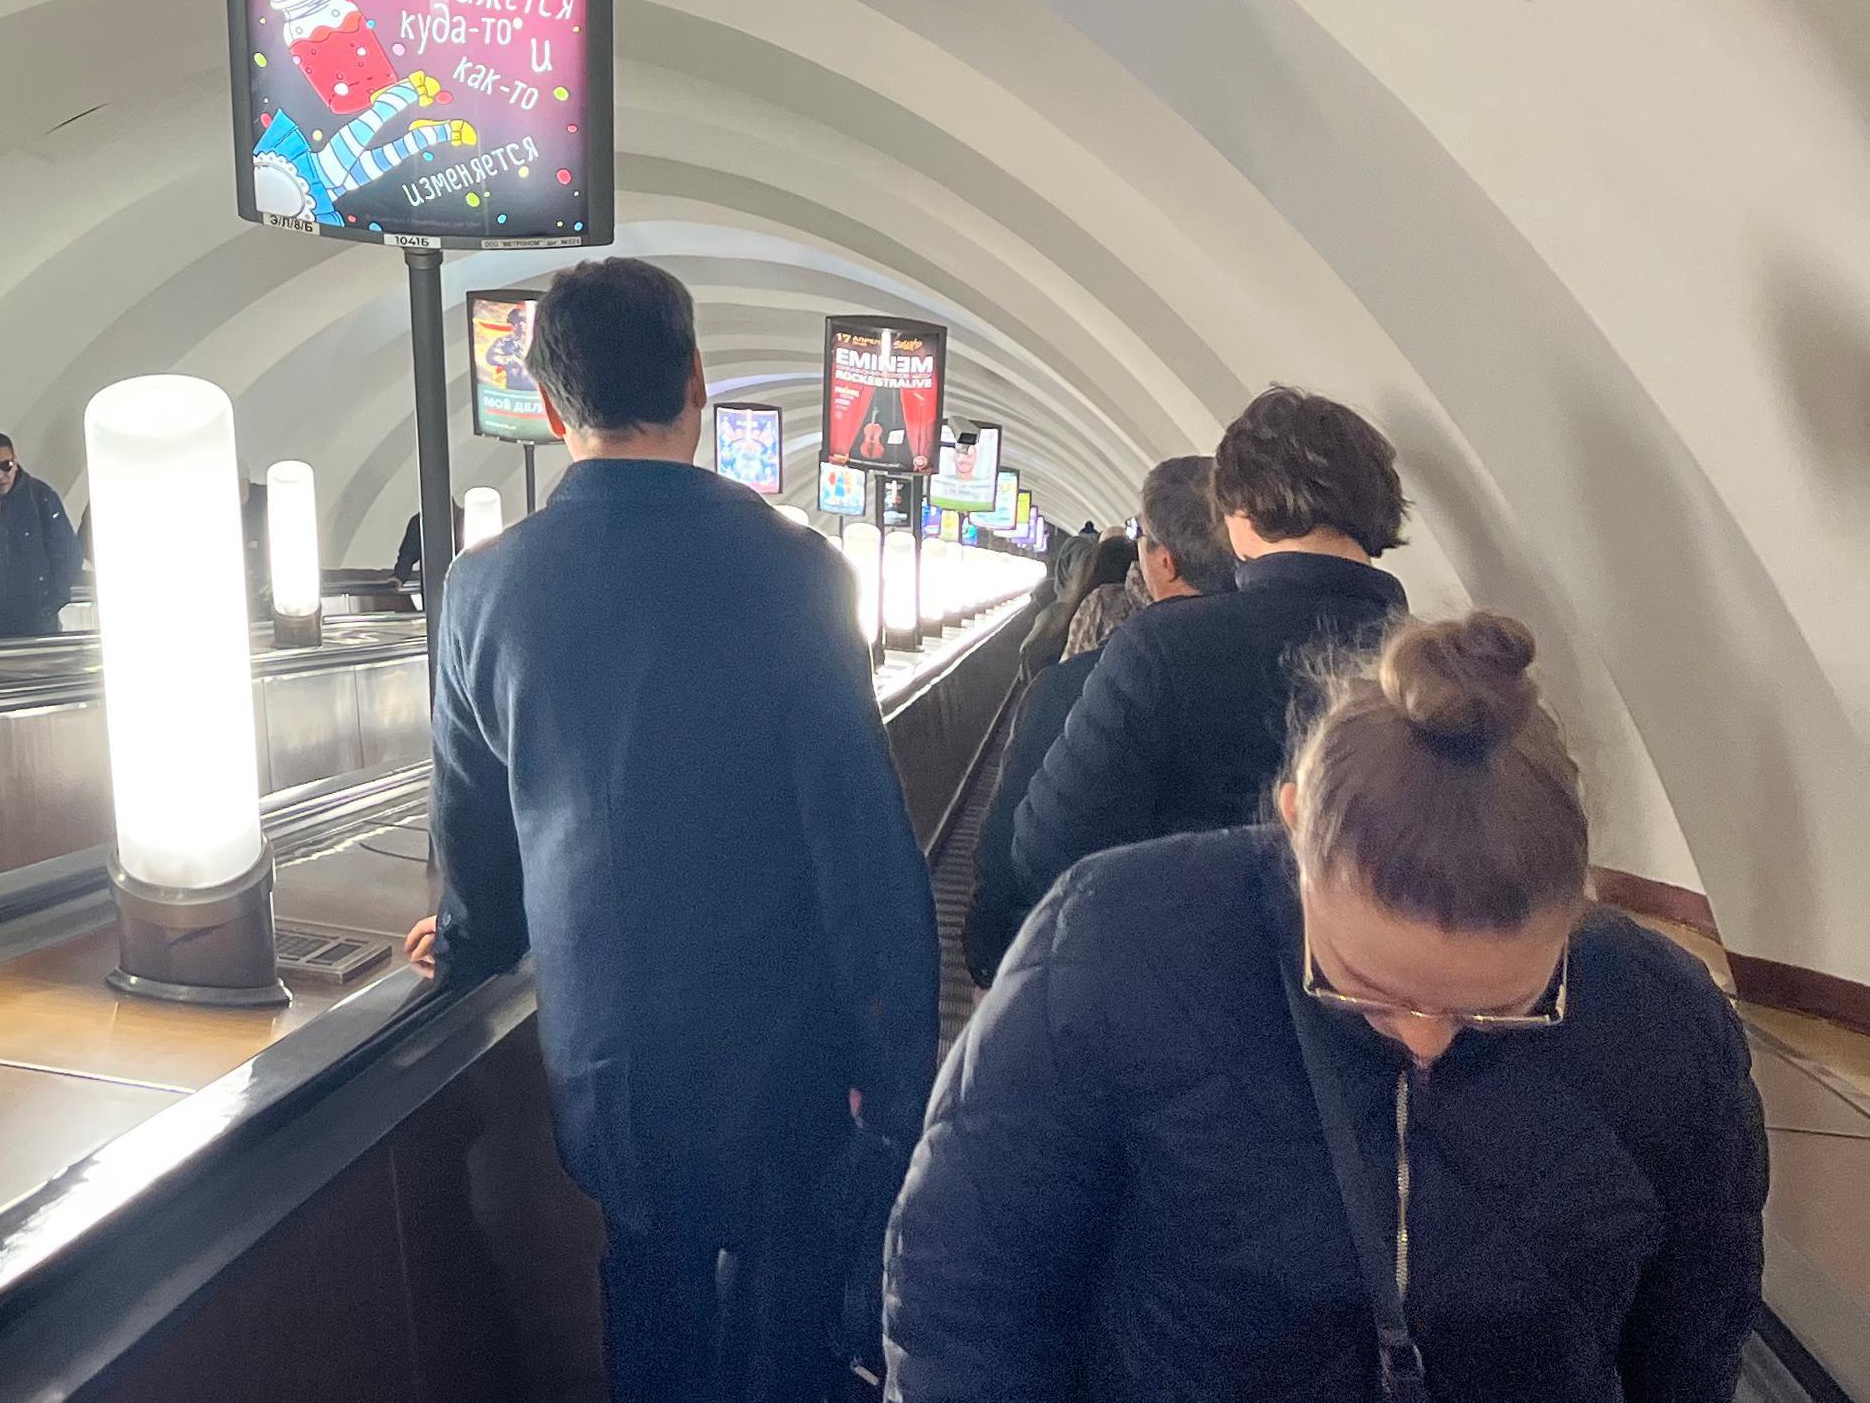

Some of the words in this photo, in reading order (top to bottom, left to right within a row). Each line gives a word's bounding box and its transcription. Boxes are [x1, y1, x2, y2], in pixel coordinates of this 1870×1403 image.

[400, 3, 512, 55] куда-то
[452, 56, 539, 110] как-то
[401, 136, 539, 207] изменяется
